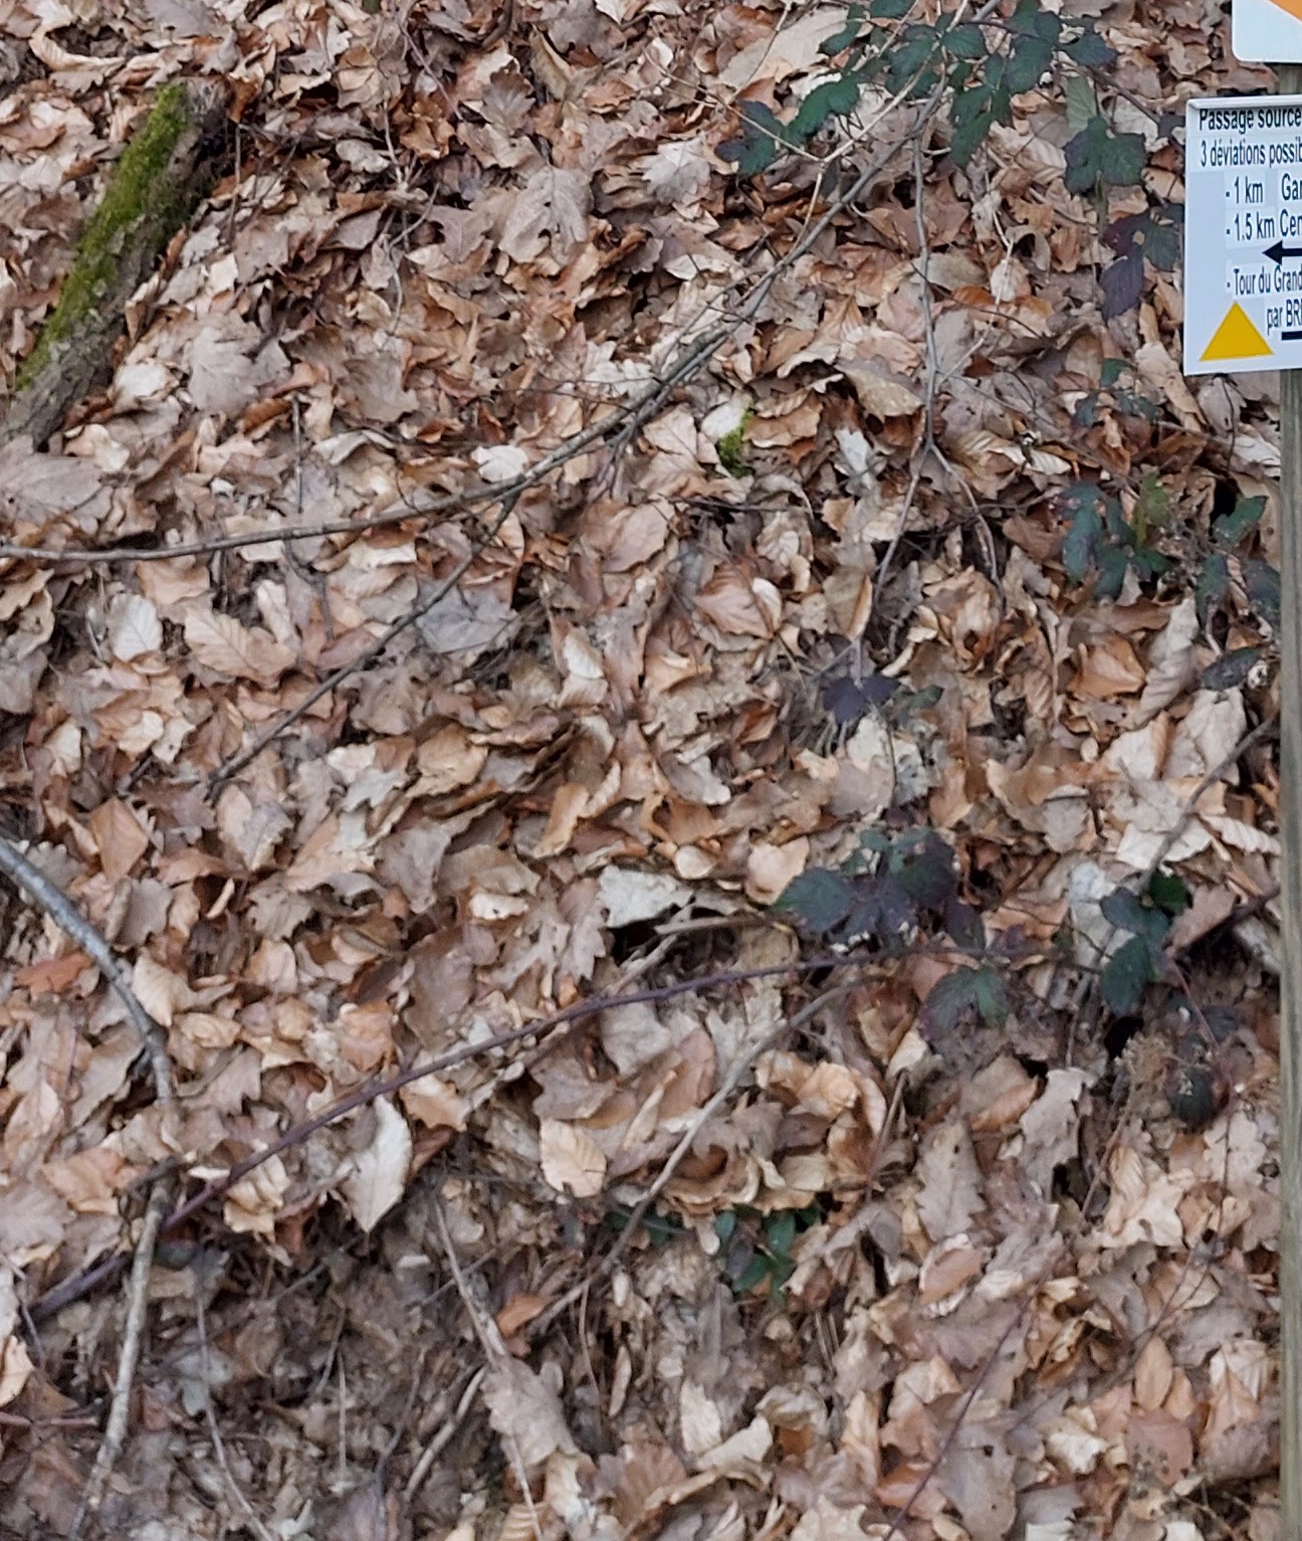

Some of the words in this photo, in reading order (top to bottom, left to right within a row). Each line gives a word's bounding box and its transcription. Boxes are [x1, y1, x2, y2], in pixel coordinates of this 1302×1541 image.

[1199, 108, 1255, 136] Passage
[1257, 107, 1302, 129] source
[1200, 139, 1208, 167] 3
[1210, 137, 1266, 167] déviations
[1245, 175, 1264, 204] km
[1234, 212, 1253, 241] 1.5
[1256, 210, 1276, 239] km
[1233, 267, 1257, 296] Tour
[1258, 265, 1272, 294] du
[1266, 307, 1284, 337] par
